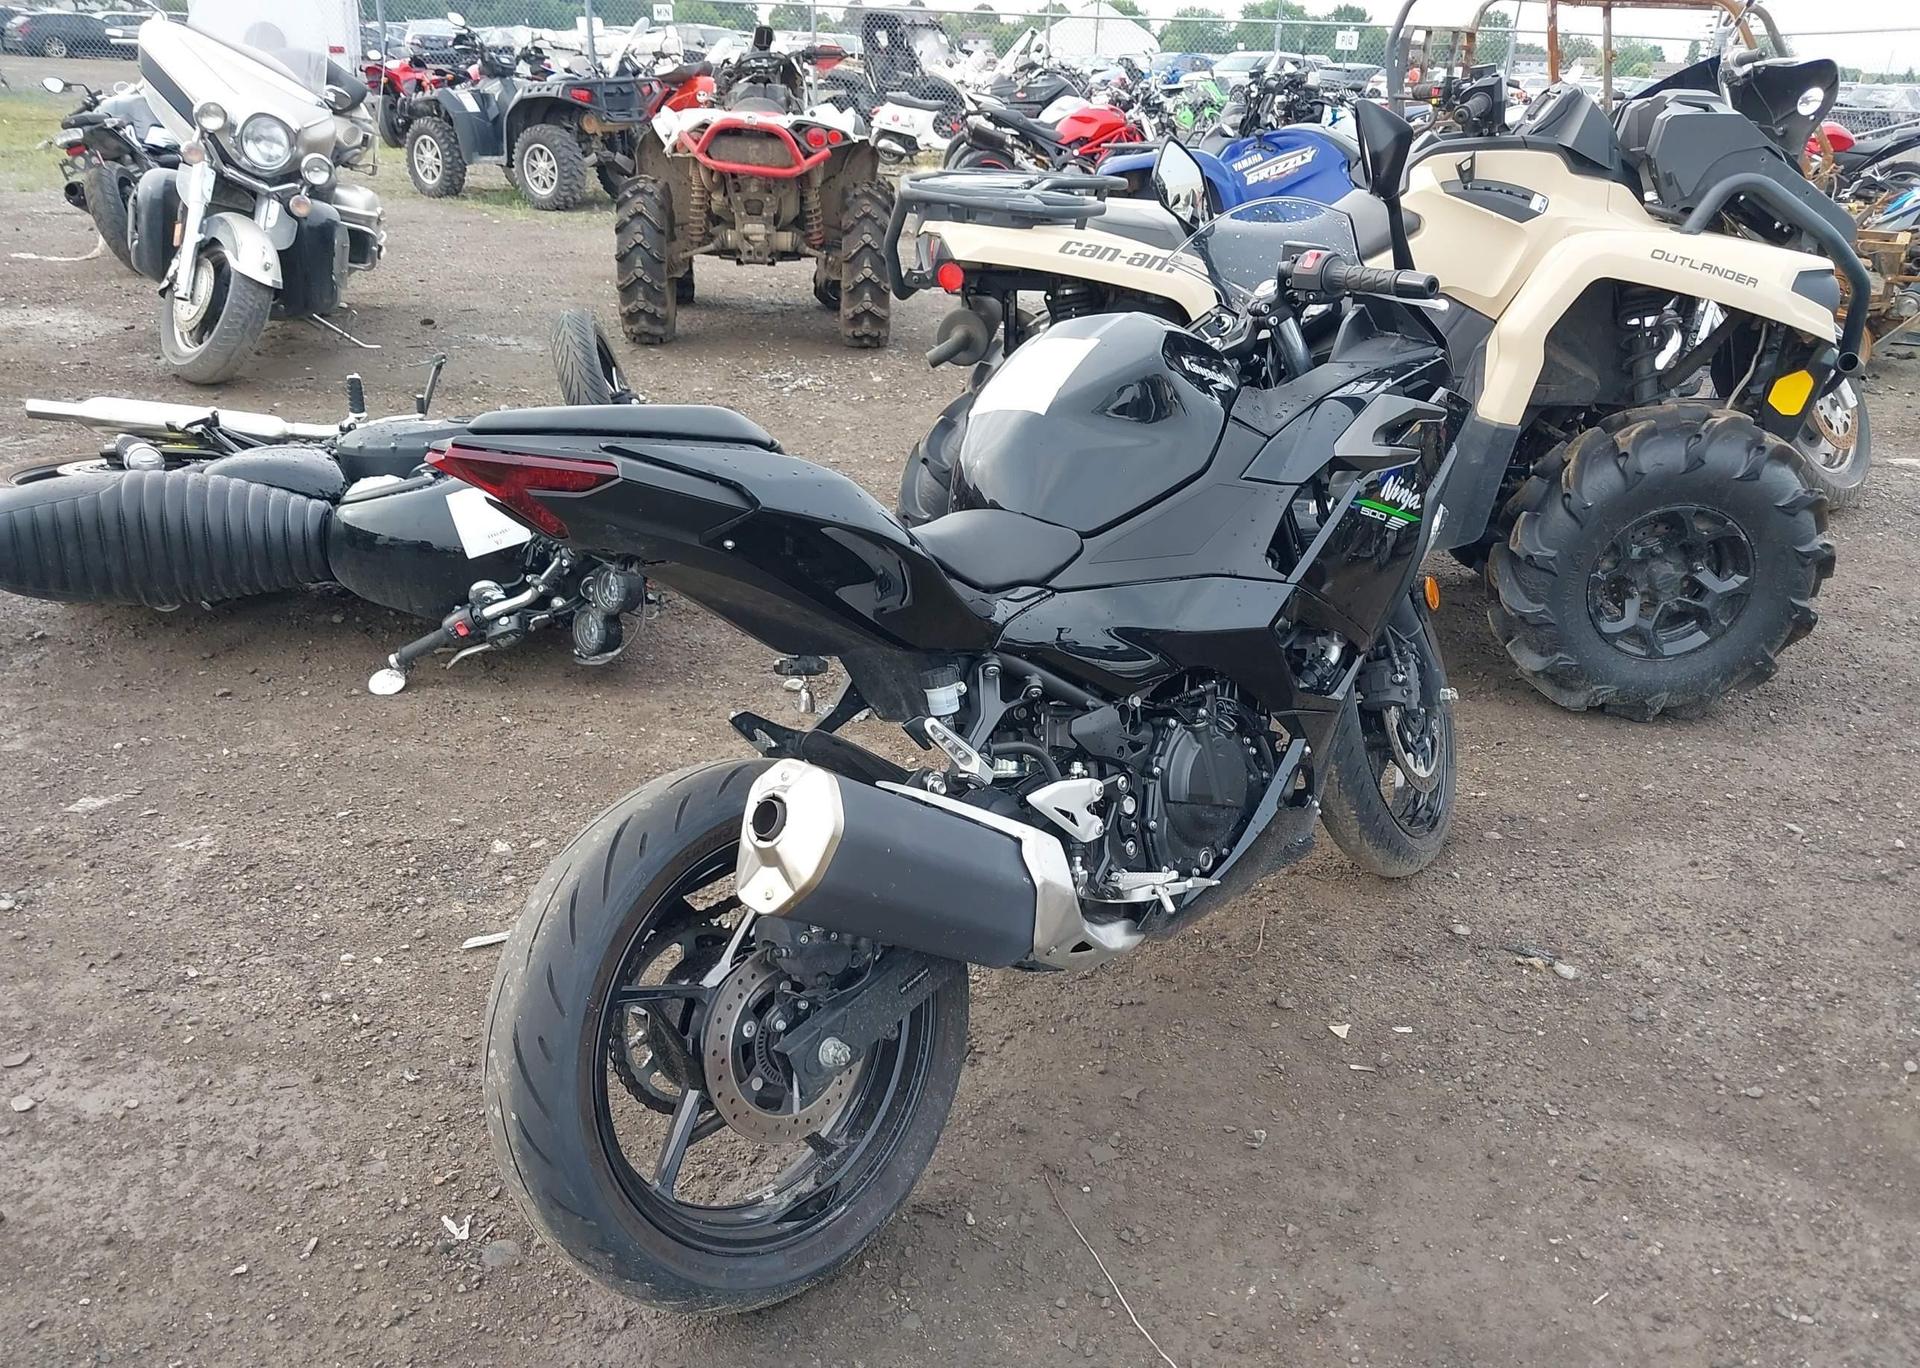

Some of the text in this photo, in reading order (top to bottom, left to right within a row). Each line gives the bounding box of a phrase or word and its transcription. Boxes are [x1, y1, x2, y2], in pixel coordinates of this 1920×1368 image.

[1231, 153, 1264, 172] YAMAHA
[1246, 146, 1317, 186] GRIZZLY
[1650, 248, 1759, 289] OUTLANDER
[1180, 355, 1237, 391] Kawasaki
[1380, 475, 1422, 513] Ninja
[1360, 506, 1387, 522] 500
